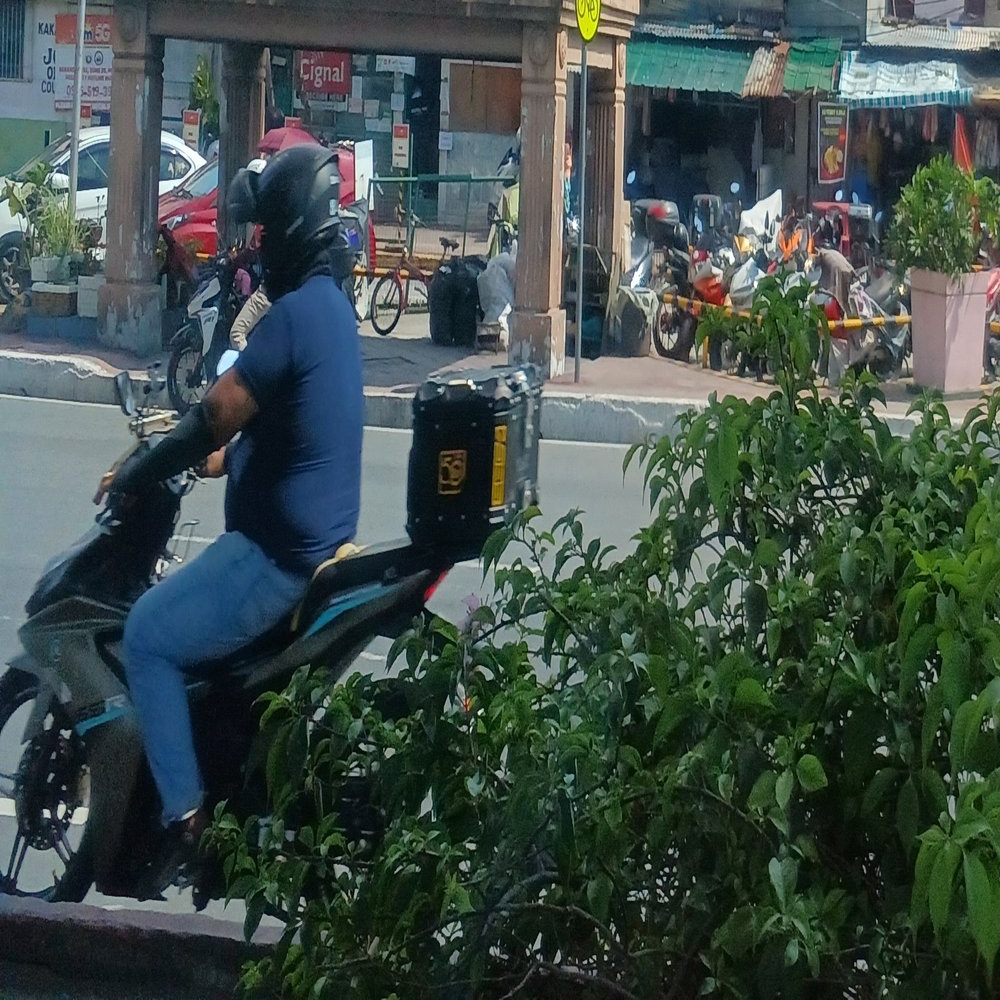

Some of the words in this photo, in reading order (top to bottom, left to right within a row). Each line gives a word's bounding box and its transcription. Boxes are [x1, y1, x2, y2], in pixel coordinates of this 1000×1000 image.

[38, 22, 55, 36] KAK
[95, 23, 111, 41] 5G
[300, 59, 344, 88] Cignal
